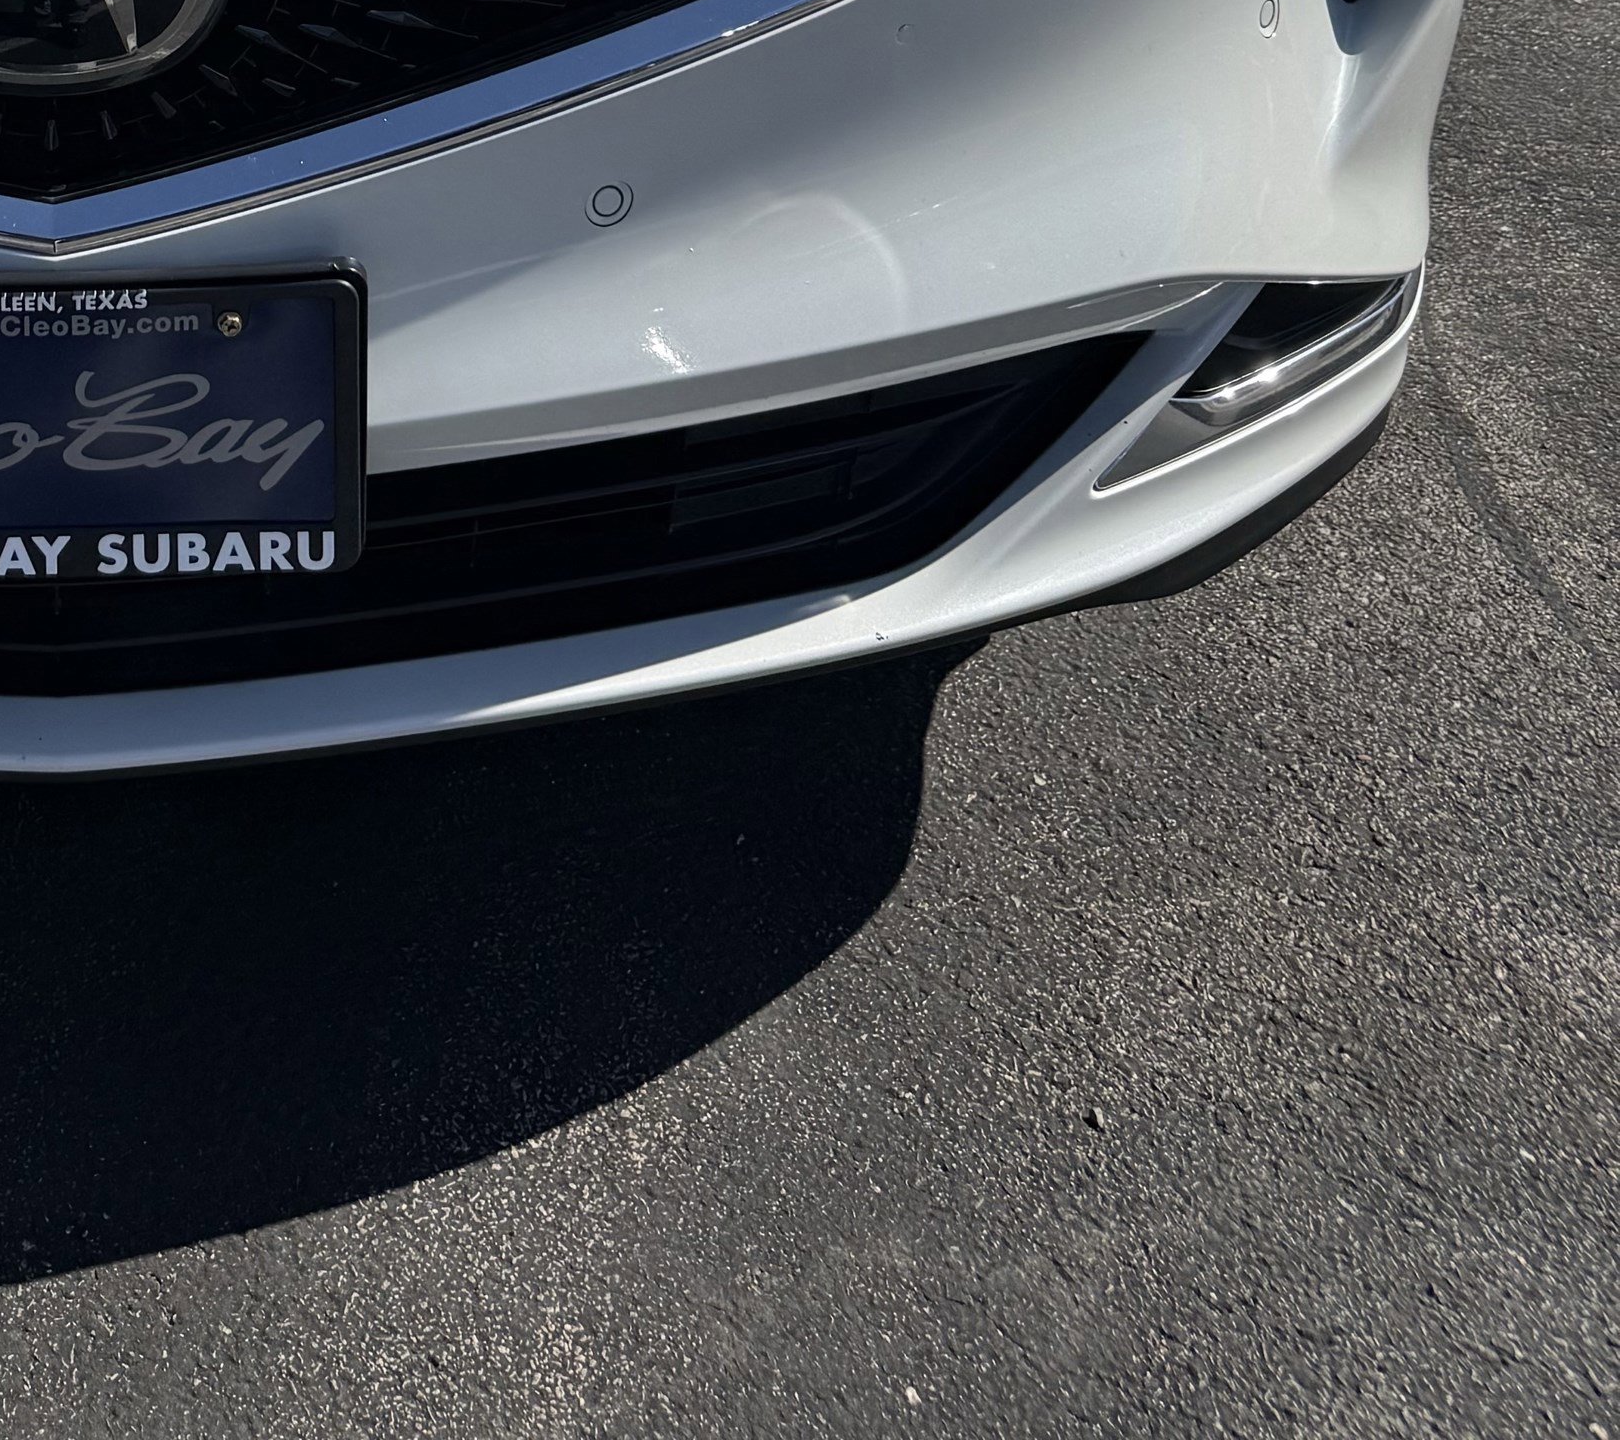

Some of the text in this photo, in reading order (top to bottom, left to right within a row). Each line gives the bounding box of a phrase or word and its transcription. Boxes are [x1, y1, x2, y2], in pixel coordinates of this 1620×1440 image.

[72, 288, 149, 311] TEXAS
[62, 370, 325, 492] Bay
[96, 530, 336, 575] SUBARU
